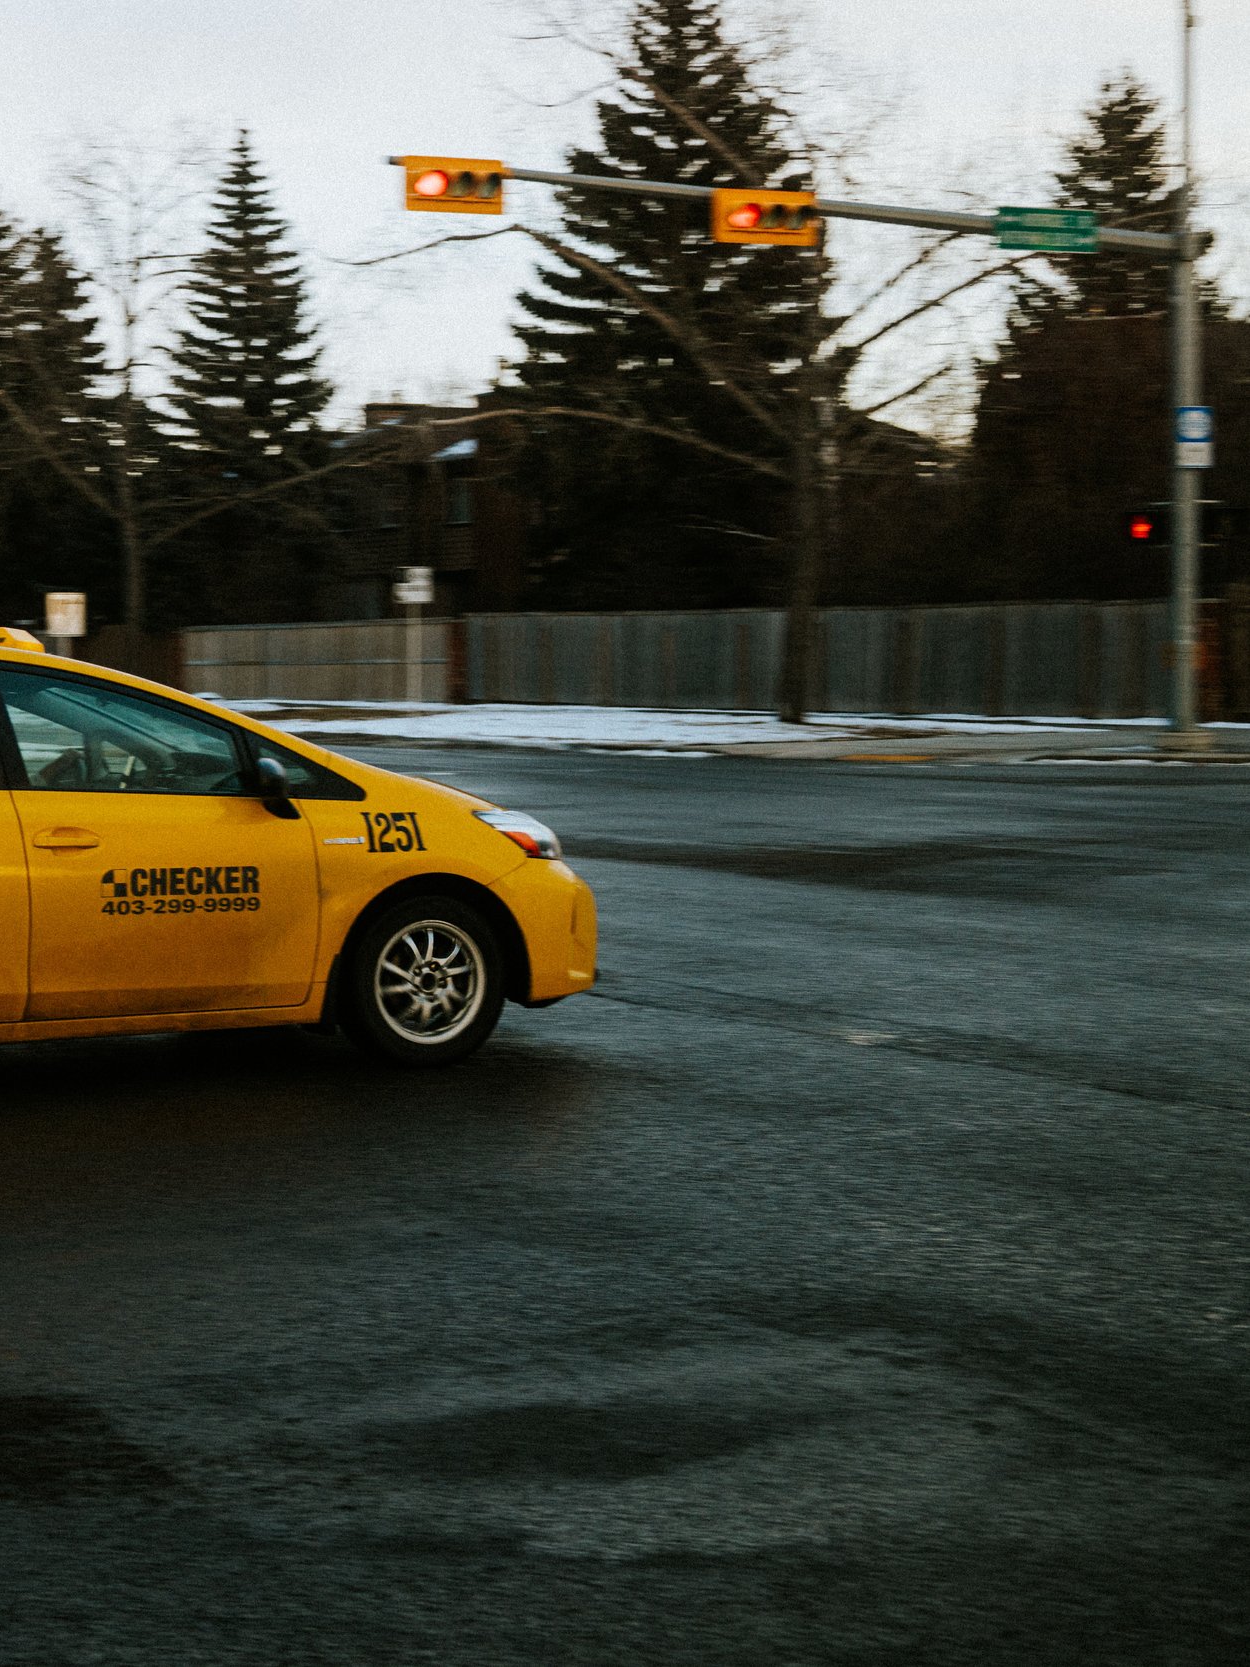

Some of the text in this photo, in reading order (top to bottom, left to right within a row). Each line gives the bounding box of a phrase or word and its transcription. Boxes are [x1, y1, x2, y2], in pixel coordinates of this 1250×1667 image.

[360, 811, 427, 853] 1251
[130, 865, 260, 897] CHECKER
[101, 897, 261, 915] 403-299-9999
